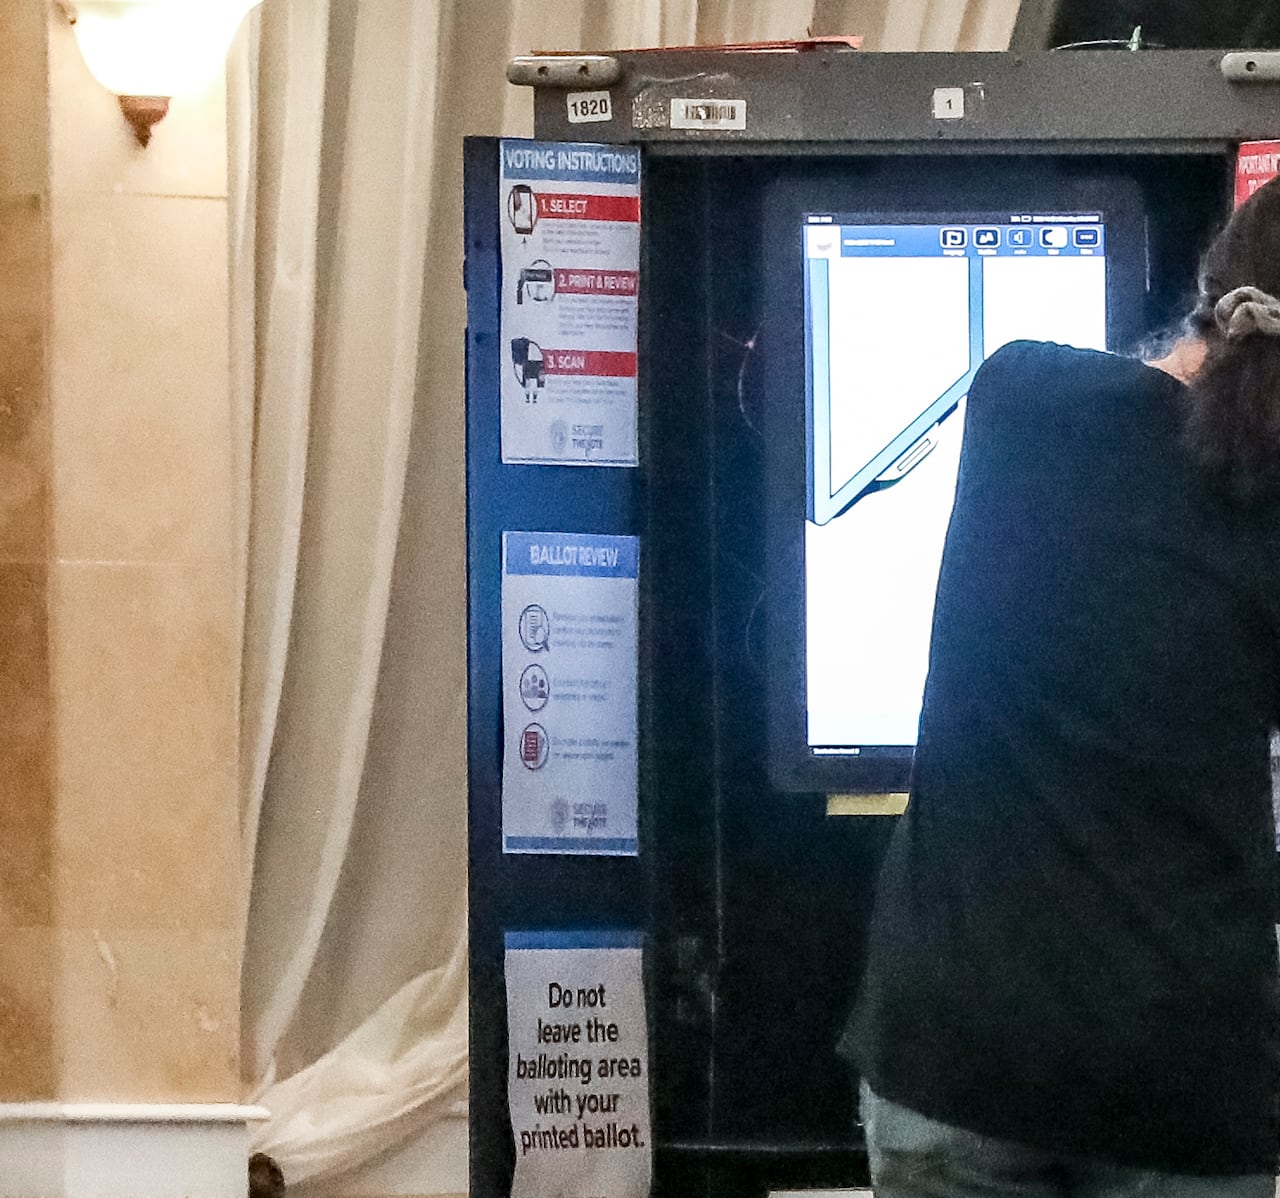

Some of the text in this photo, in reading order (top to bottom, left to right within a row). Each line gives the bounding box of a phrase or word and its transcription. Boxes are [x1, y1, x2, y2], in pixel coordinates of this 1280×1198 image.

[570, 98, 608, 117] 1820
[946, 99, 952, 110] 1
[504, 149, 637, 174] VOTING INSTRUCTIONS
[541, 200, 588, 213] 1. SELECT
[559, 274, 567, 287] 2.
[569, 274, 595, 288] PRINT
[604, 276, 635, 290] REVIEW
[548, 356, 584, 368] 3. SCAN
[530, 545, 618, 568] BALLOT REVIEW
[549, 983, 606, 1008] Do not
[538, 1018, 618, 1044] leave the
[517, 1054, 642, 1084] balloting area
[534, 1088, 620, 1120] with your
[520, 1123, 645, 1156] printed ballot.
